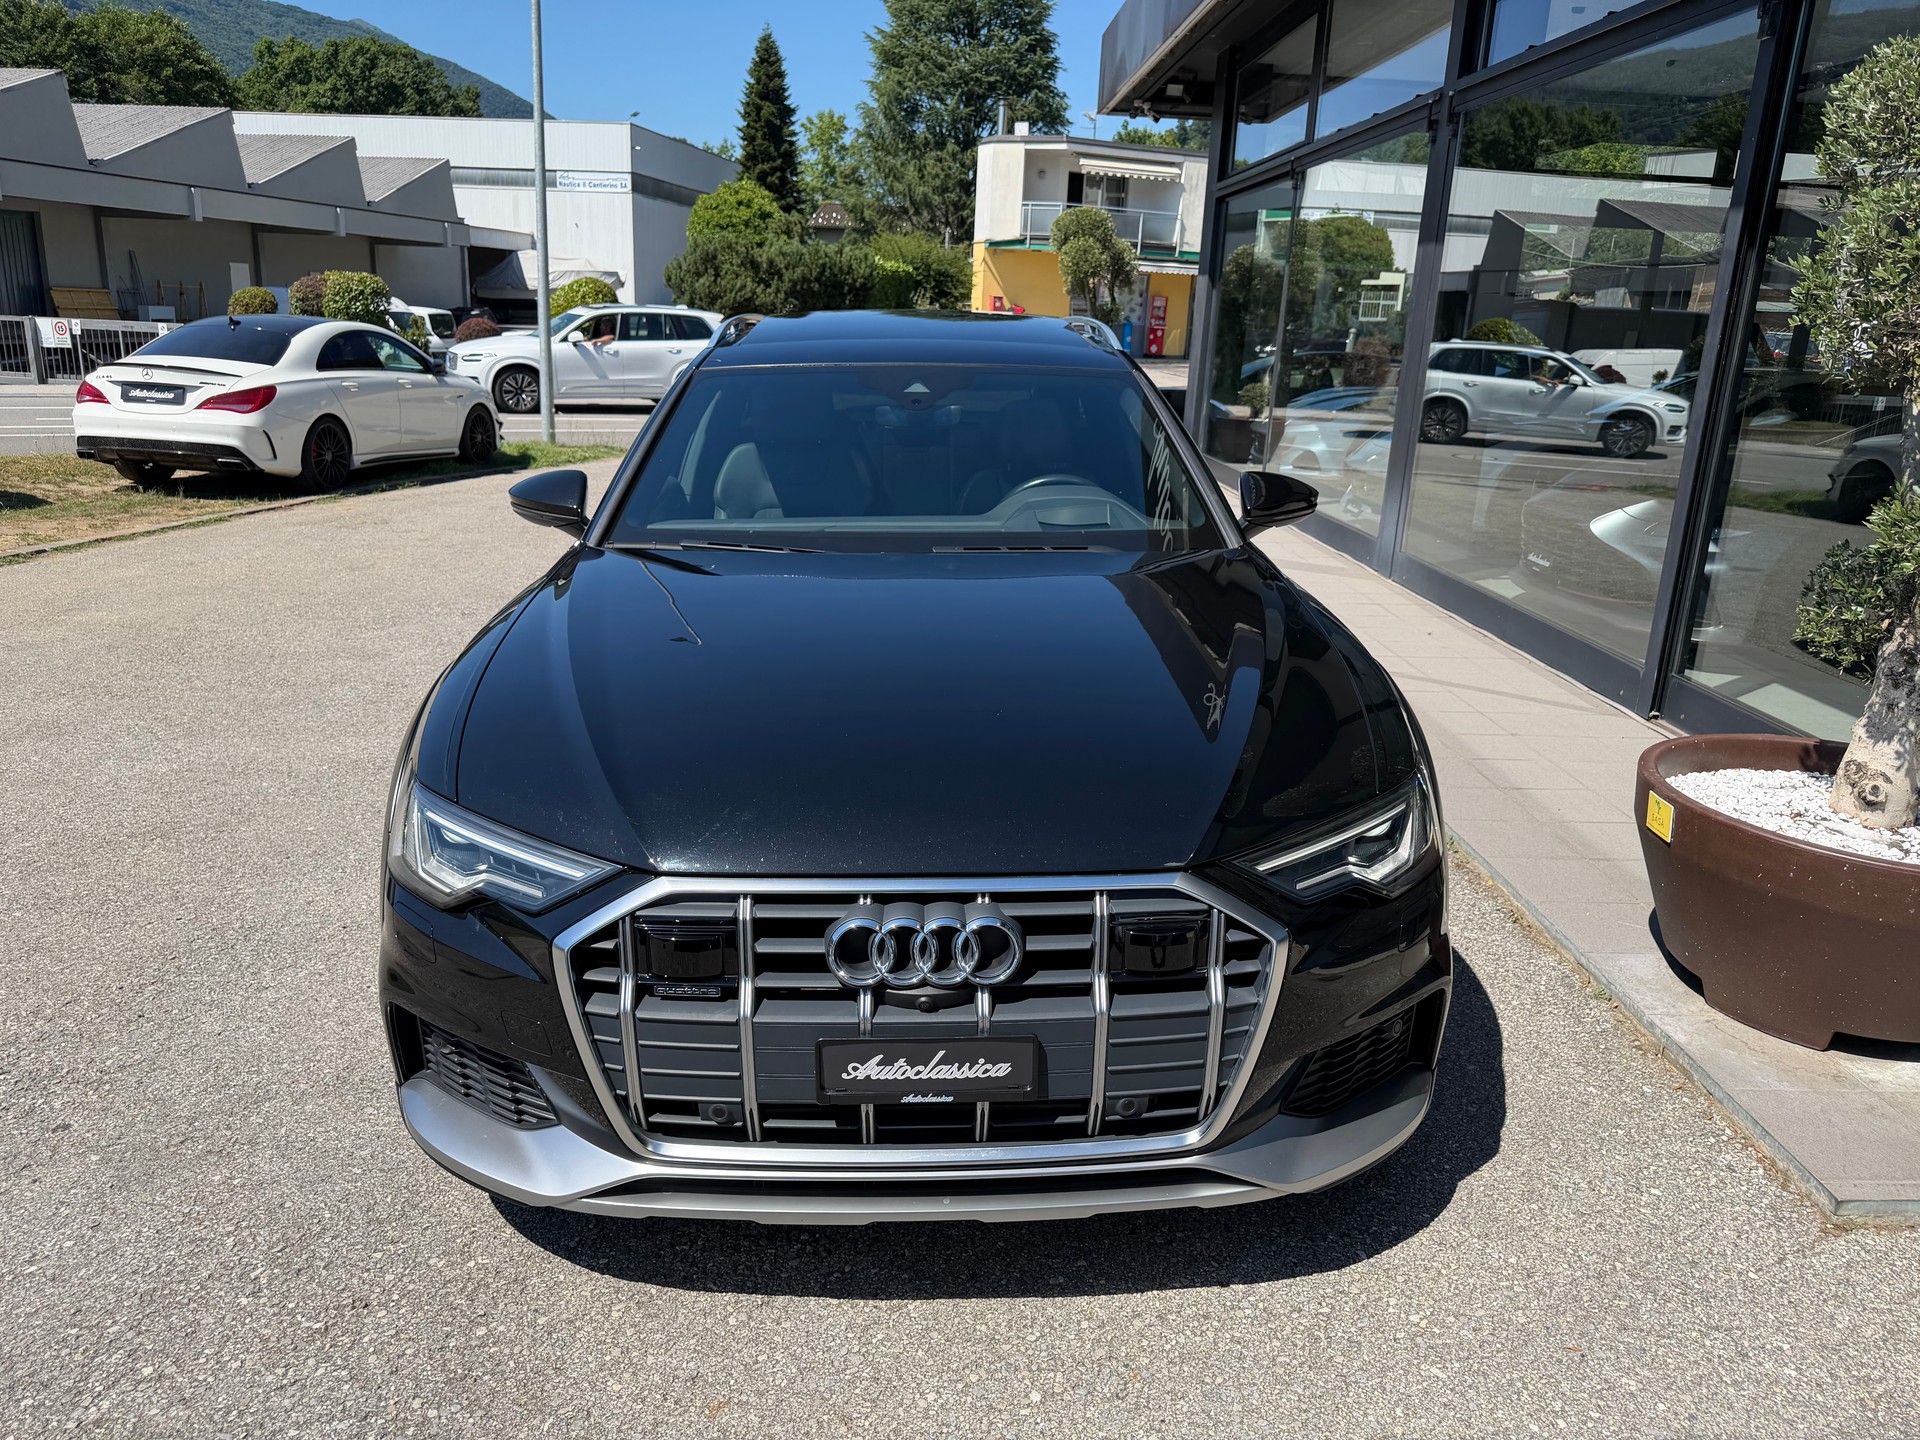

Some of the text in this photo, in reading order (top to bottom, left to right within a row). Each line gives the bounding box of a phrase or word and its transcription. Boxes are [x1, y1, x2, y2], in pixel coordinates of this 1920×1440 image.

[656, 987, 717, 995] quattro
[842, 1050, 1012, 1079] Autoclassica
[901, 1094, 954, 1103] Autoclassica
